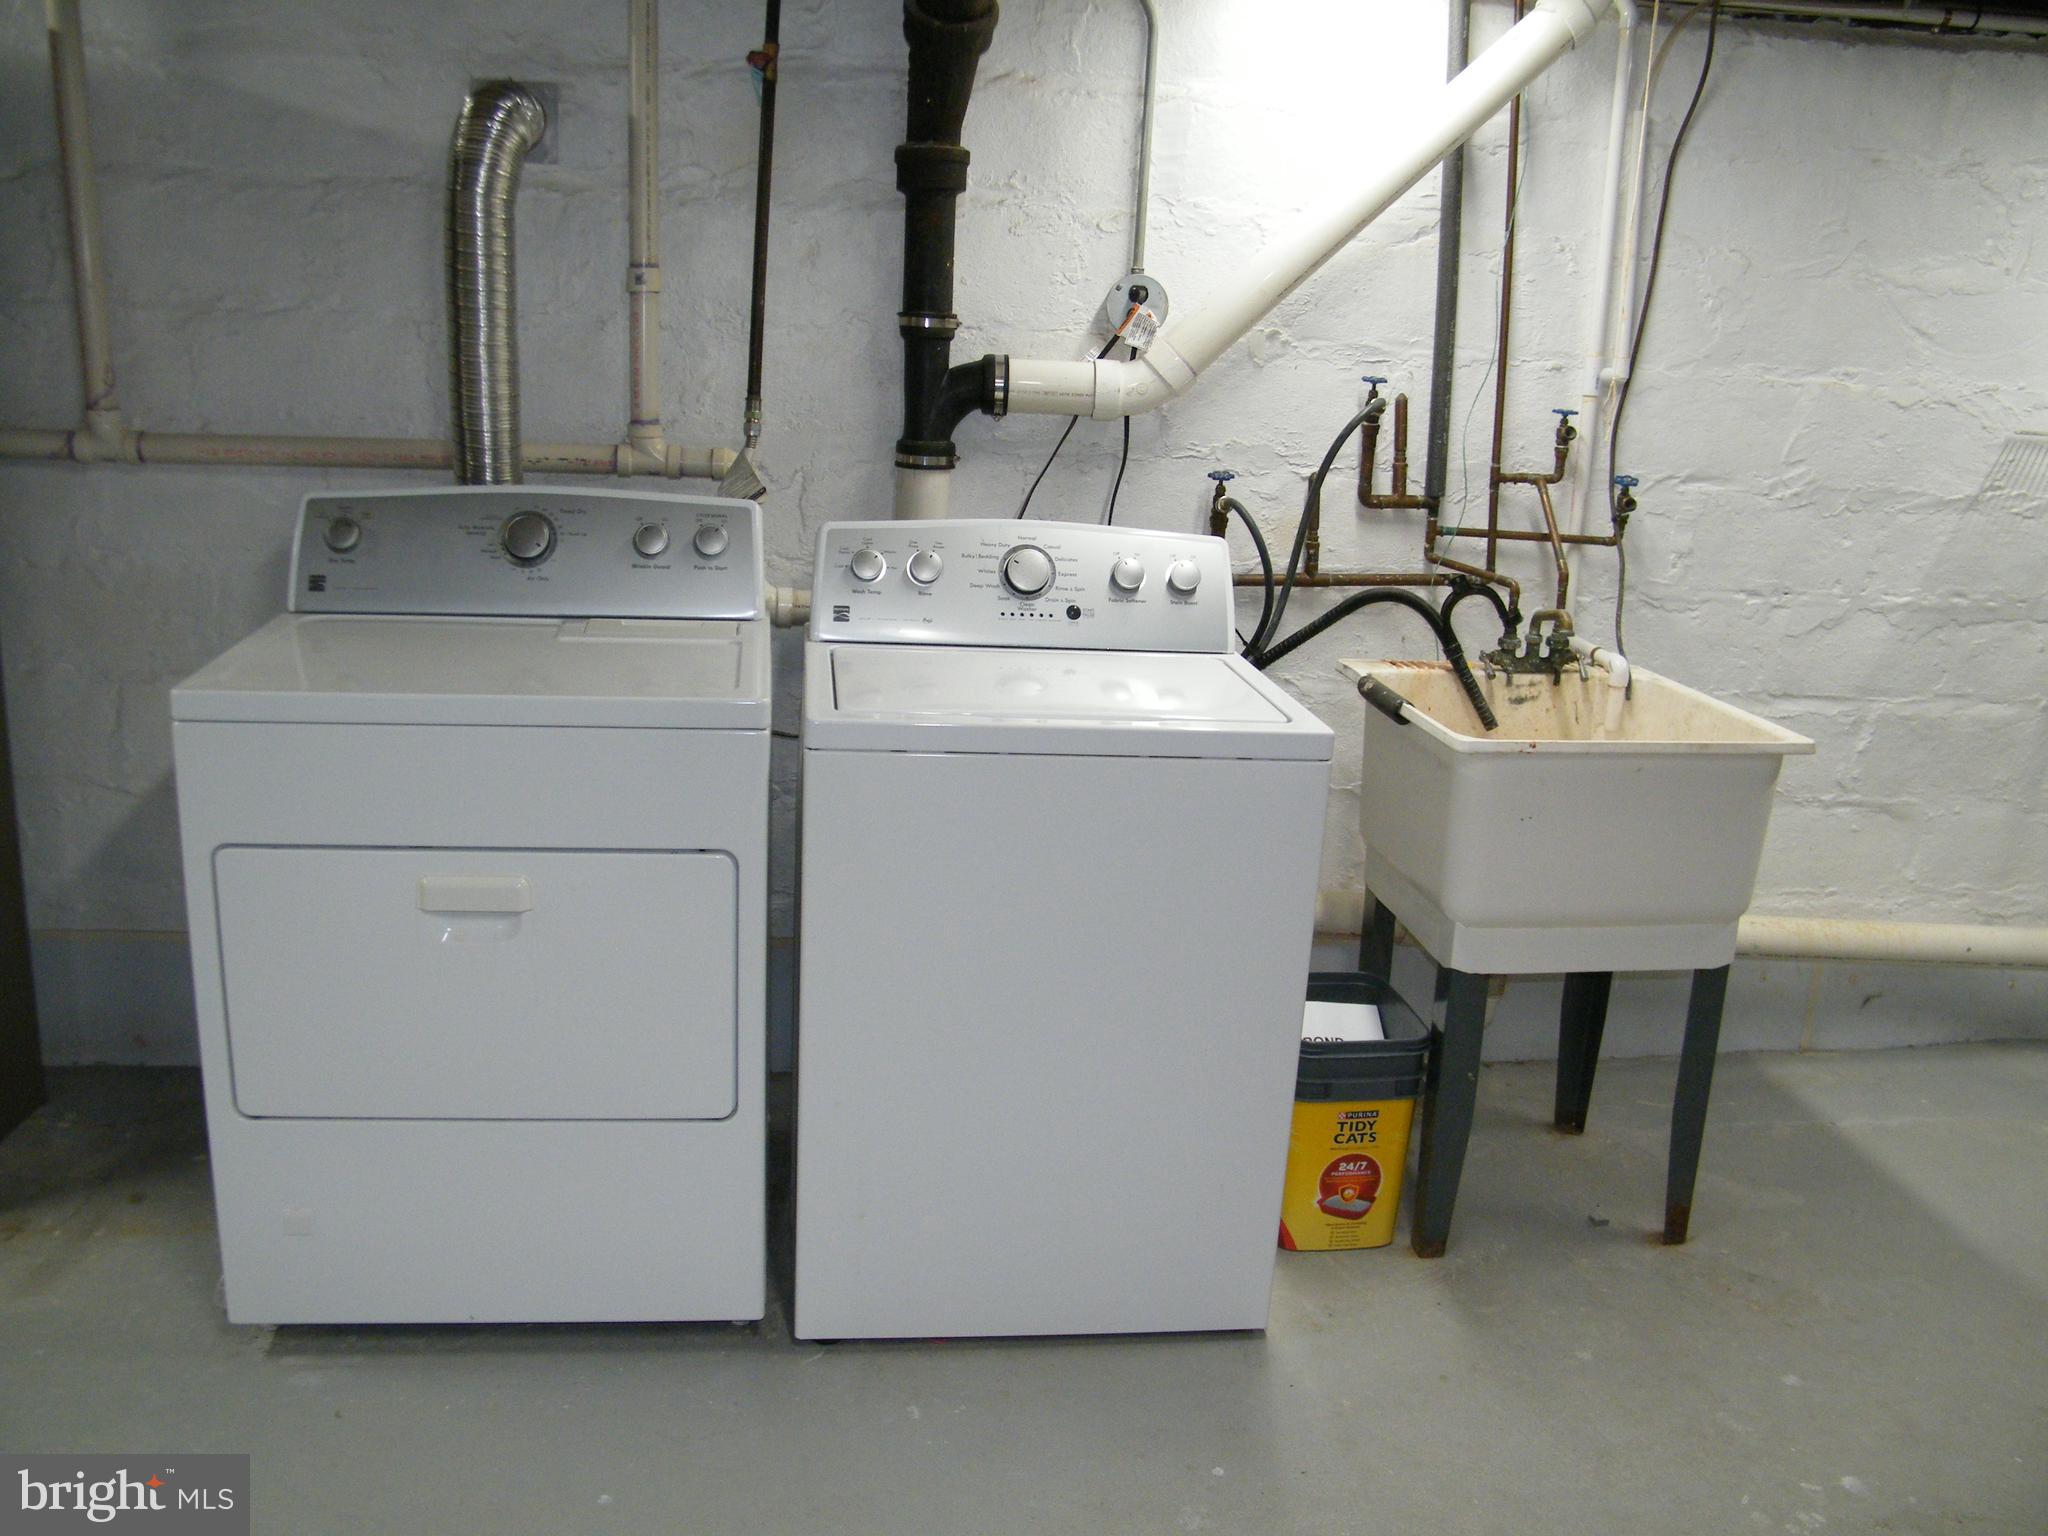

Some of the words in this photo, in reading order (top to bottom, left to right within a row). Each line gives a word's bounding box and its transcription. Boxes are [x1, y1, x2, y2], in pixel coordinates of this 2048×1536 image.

[1347, 1111, 1378, 1119] PURINA
[1337, 1120, 1377, 1132] TIDY
[1333, 1132, 1377, 1144] CATS
[1339, 1161, 1368, 1171] 24/7
